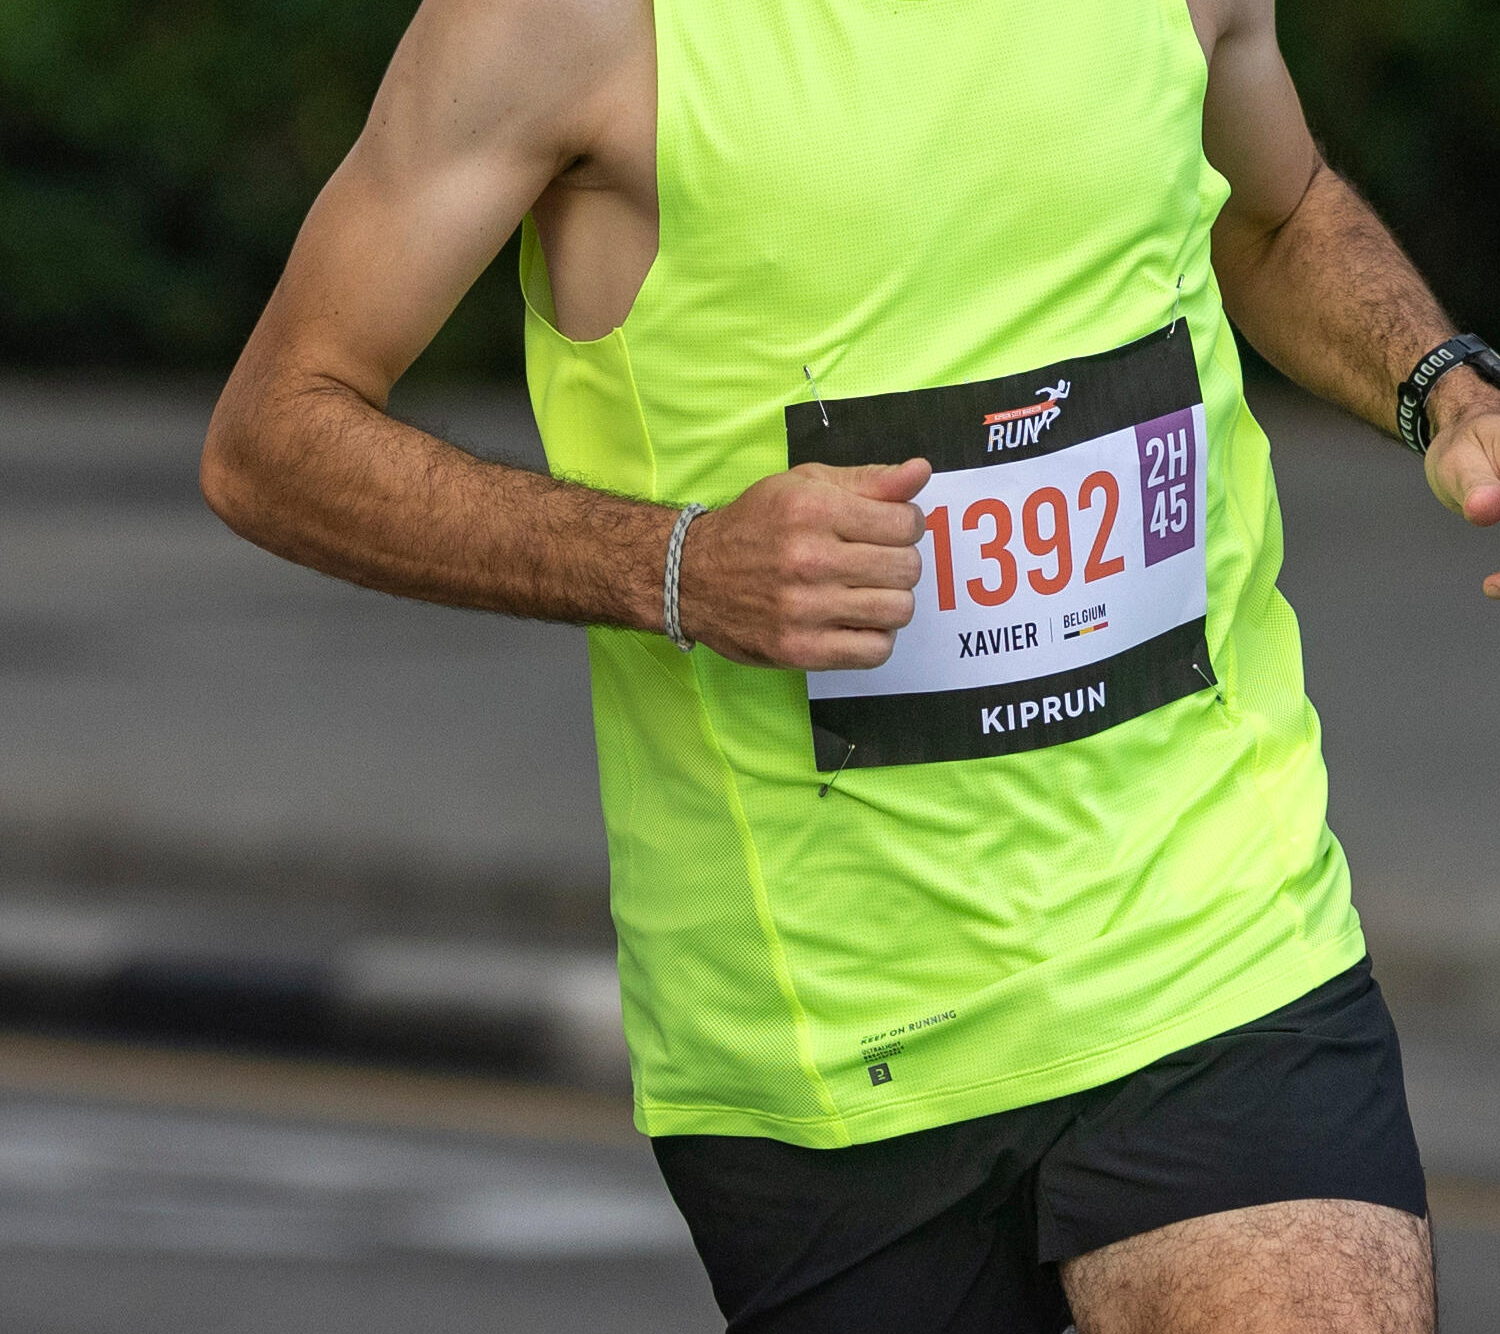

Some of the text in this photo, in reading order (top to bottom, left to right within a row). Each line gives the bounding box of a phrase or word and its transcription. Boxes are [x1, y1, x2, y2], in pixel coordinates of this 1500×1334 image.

[987, 416, 1039, 452] RUN
[1145, 429, 1188, 488] 2H
[1149, 485, 1189, 538] 45
[924, 470, 1125, 611] 1392
[958, 603, 1107, 659] XAVIER BELGIUM
[981, 682, 1106, 734] KIPRUN
[890, 1027, 905, 1037] ON
[908, 1010, 957, 1032] RUNNING
